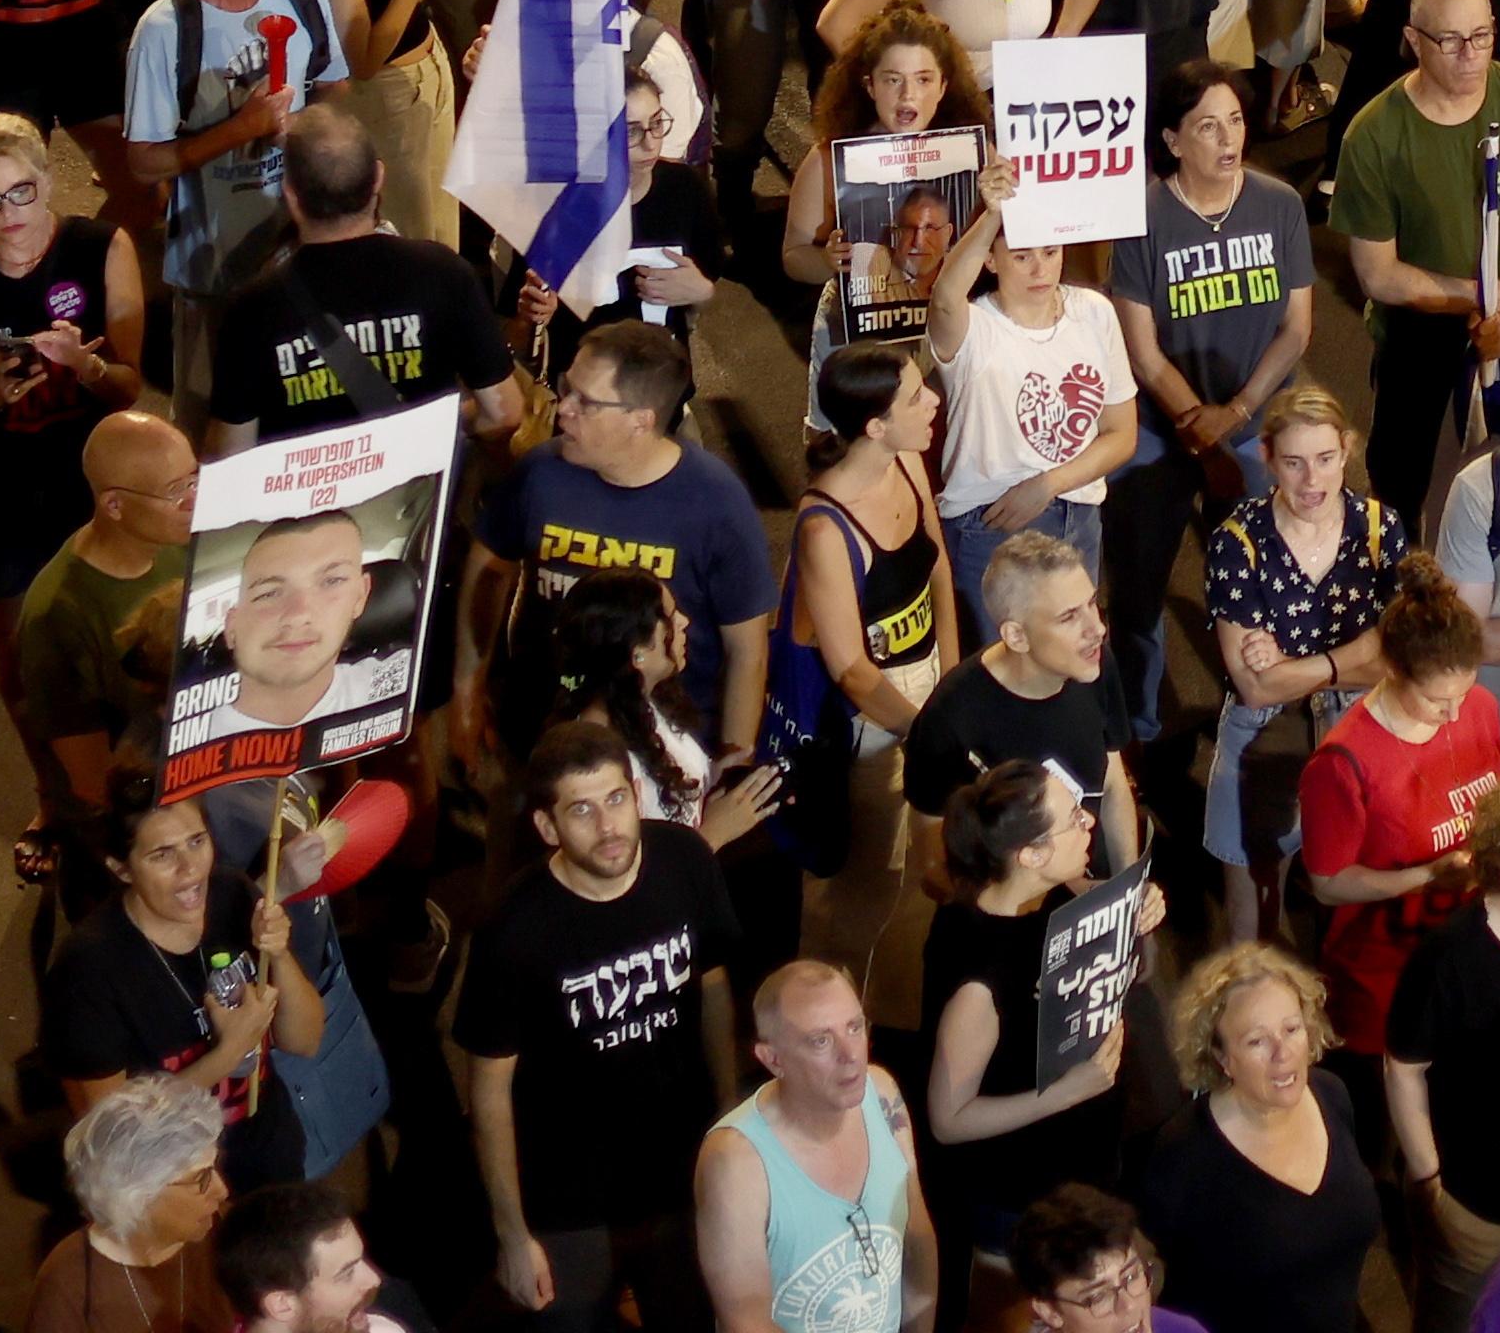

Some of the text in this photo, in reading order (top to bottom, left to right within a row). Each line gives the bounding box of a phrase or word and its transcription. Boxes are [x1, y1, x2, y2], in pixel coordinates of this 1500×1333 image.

[1006, 95, 1136, 153] עסקה
[1010, 144, 1135, 184] עכשיו
[1163, 233, 1275, 280] אתם בבית
[1168, 266, 1280, 320] הם בעזה!
[263, 452, 385, 494] BAR KUPERSHTEIN
[282, 434, 372, 471] בר קופרשטיין
[308, 484, 338, 511] (22)
[542, 523, 677, 581] מאבק
[170, 671, 240, 720] BRING
[169, 711, 214, 756] HIM
[163, 723, 304, 792] HOME NOW!
